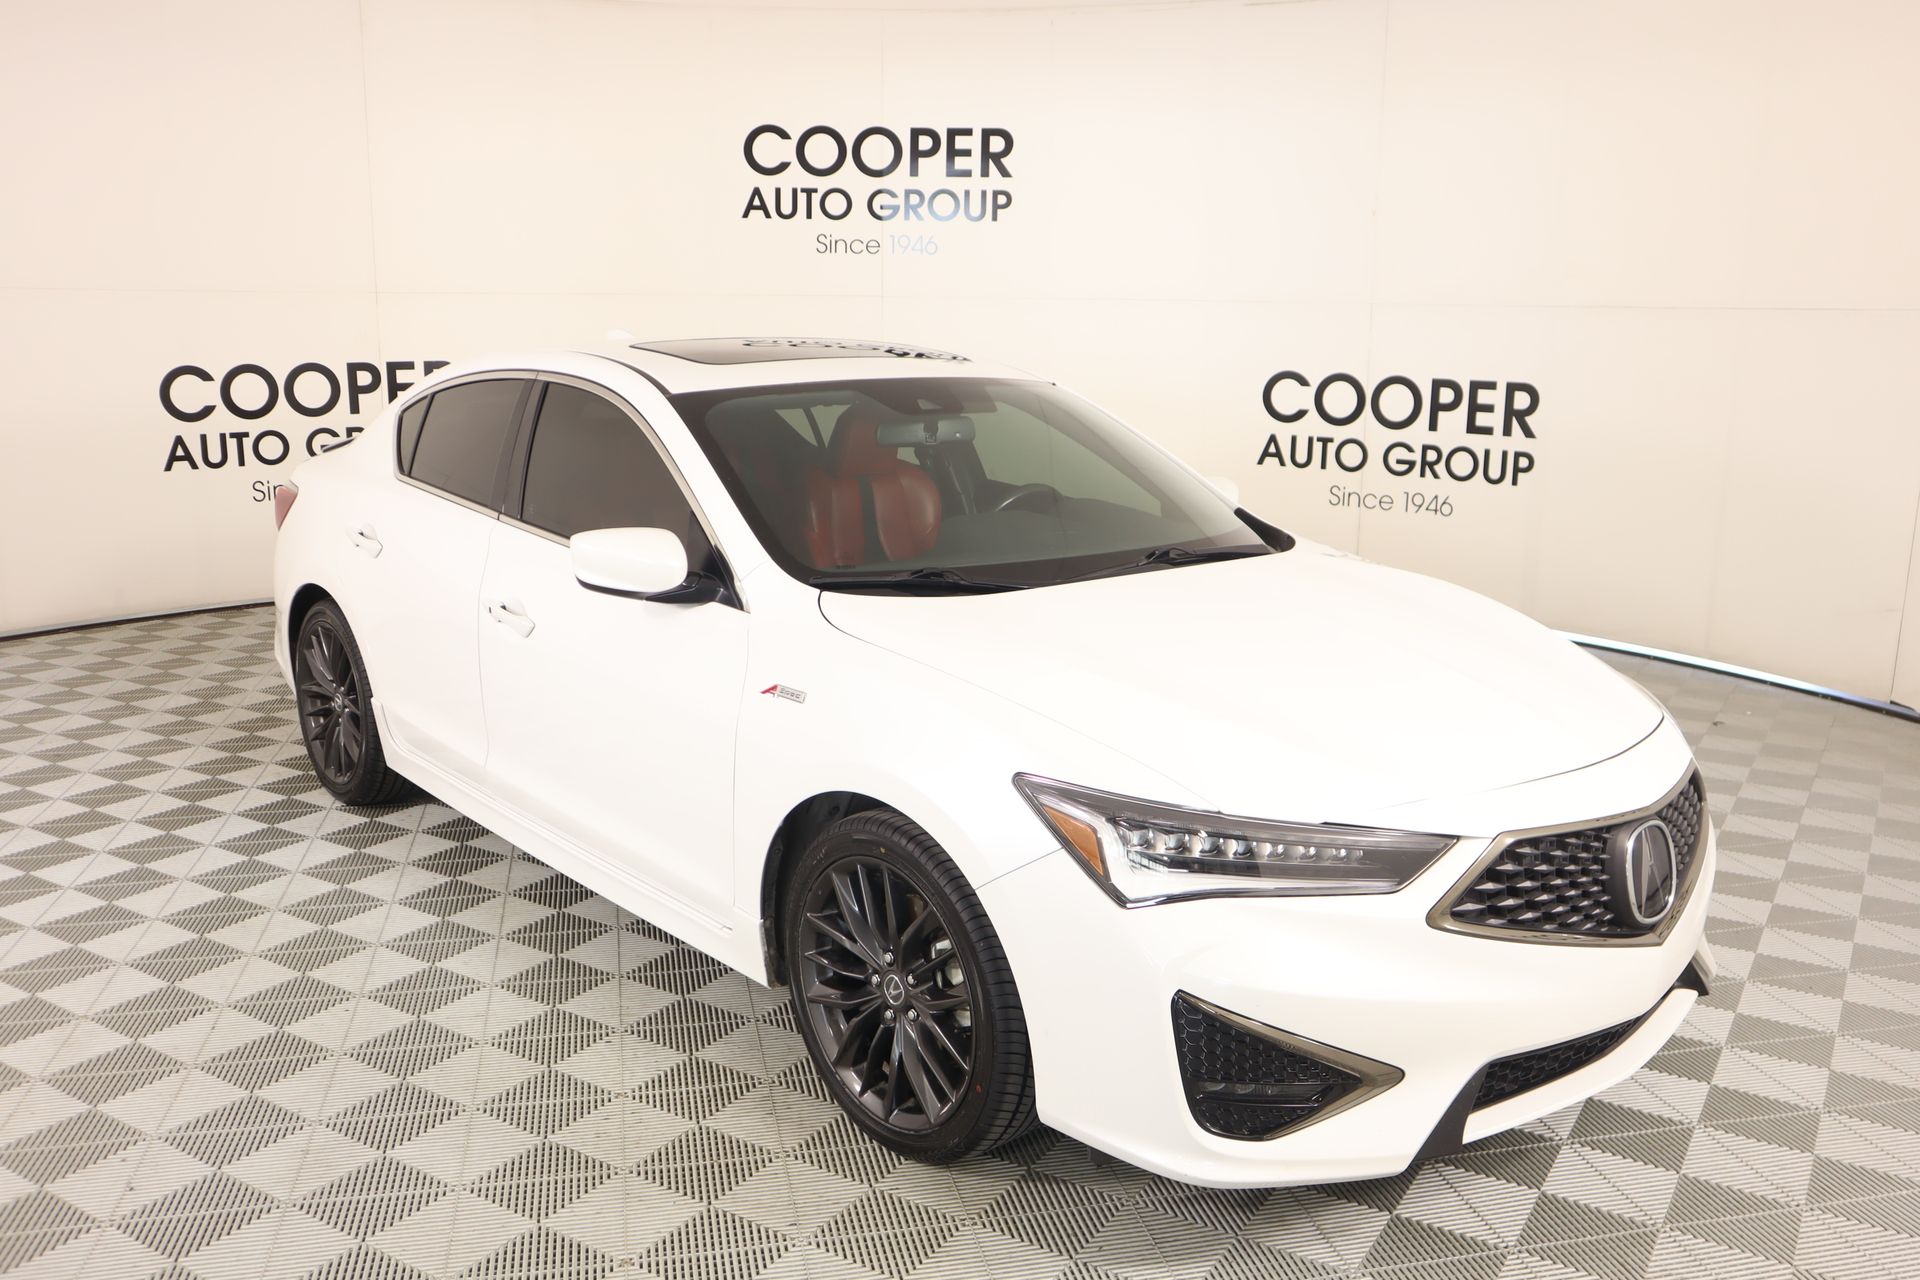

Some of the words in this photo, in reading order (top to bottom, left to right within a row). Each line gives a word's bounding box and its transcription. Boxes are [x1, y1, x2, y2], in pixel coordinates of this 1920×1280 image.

[743, 124, 1014, 178] COOPER
[742, 186, 853, 220] AUTO
[867, 188, 1013, 222] GROUP
[816, 233, 881, 254] Since
[889, 234, 938, 256] 1946
[159, 360, 451, 423] COOPE
[1262, 370, 1540, 439] COOPER
[163, 430, 290, 472] AUTO
[1257, 433, 1368, 473] AUTO
[1383, 441, 1535, 487] GROUP
[1328, 485, 1394, 511] Since
[1403, 491, 1454, 517] 1946
